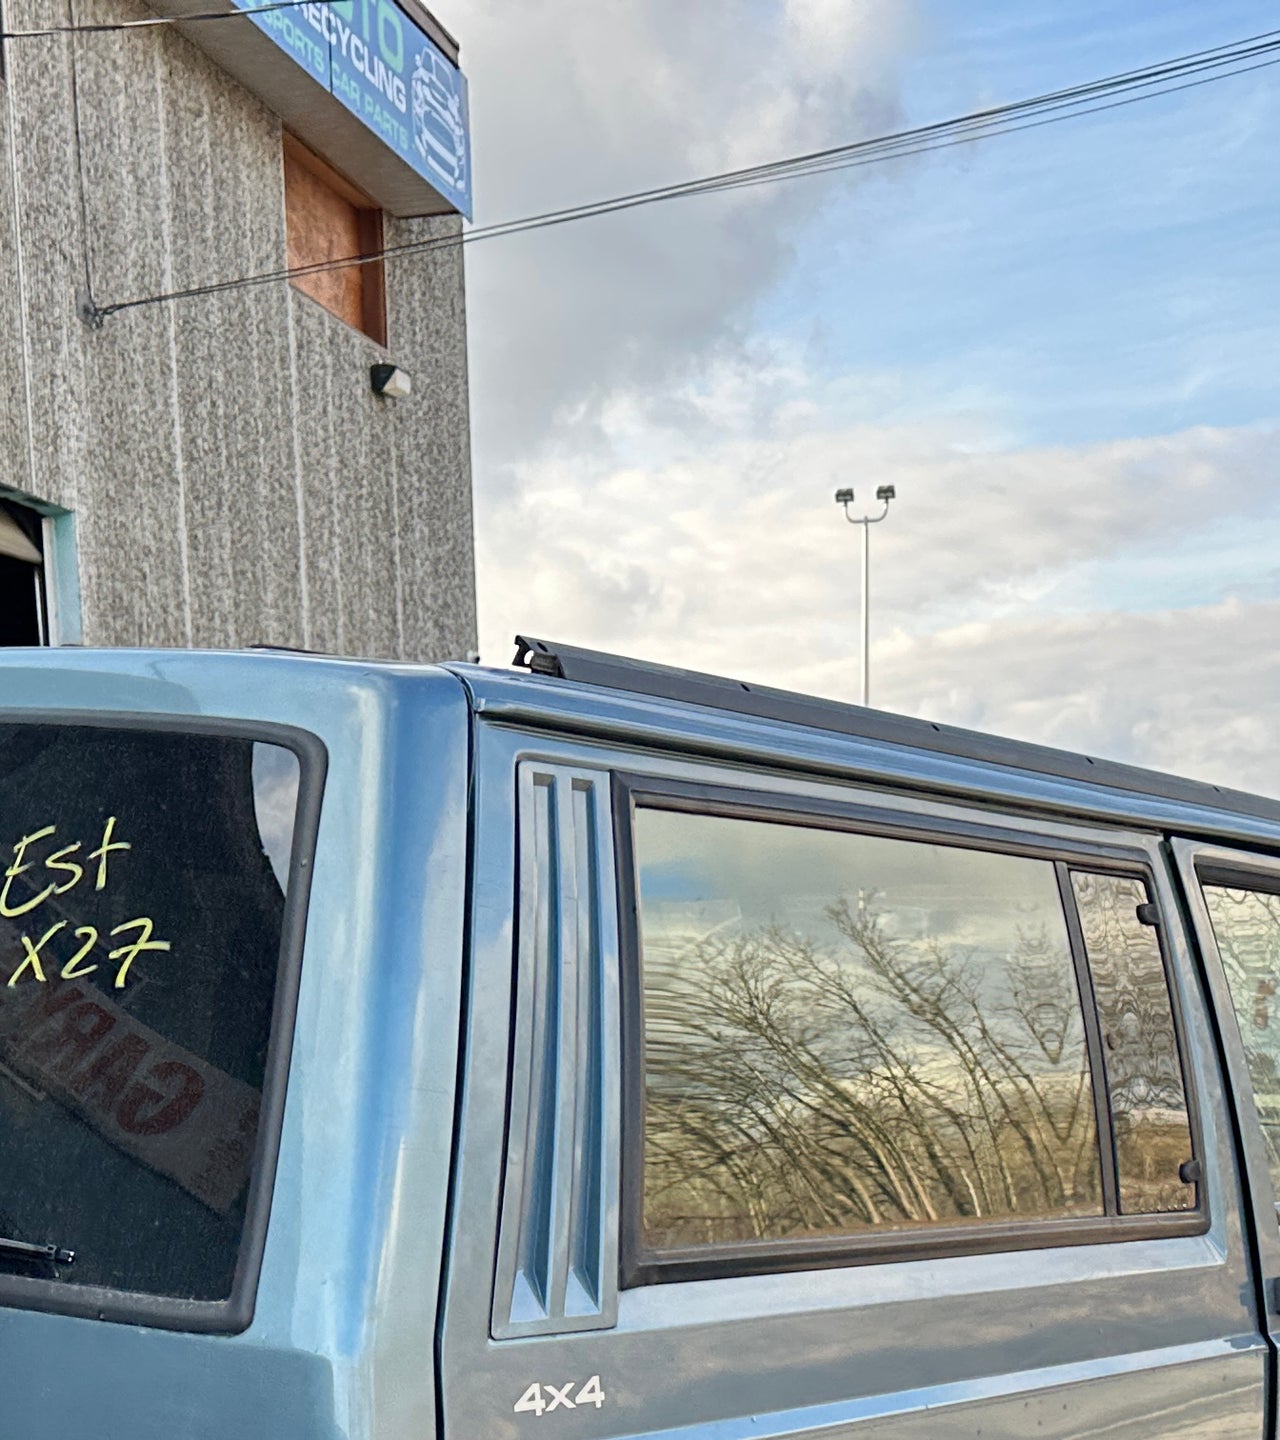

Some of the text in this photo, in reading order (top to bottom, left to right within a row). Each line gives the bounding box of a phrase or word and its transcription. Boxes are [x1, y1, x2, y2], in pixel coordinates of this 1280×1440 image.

[332, 65, 361, 108] CAR
[365, 97, 408, 150] PARTS
[0, 816, 131, 917] Est
